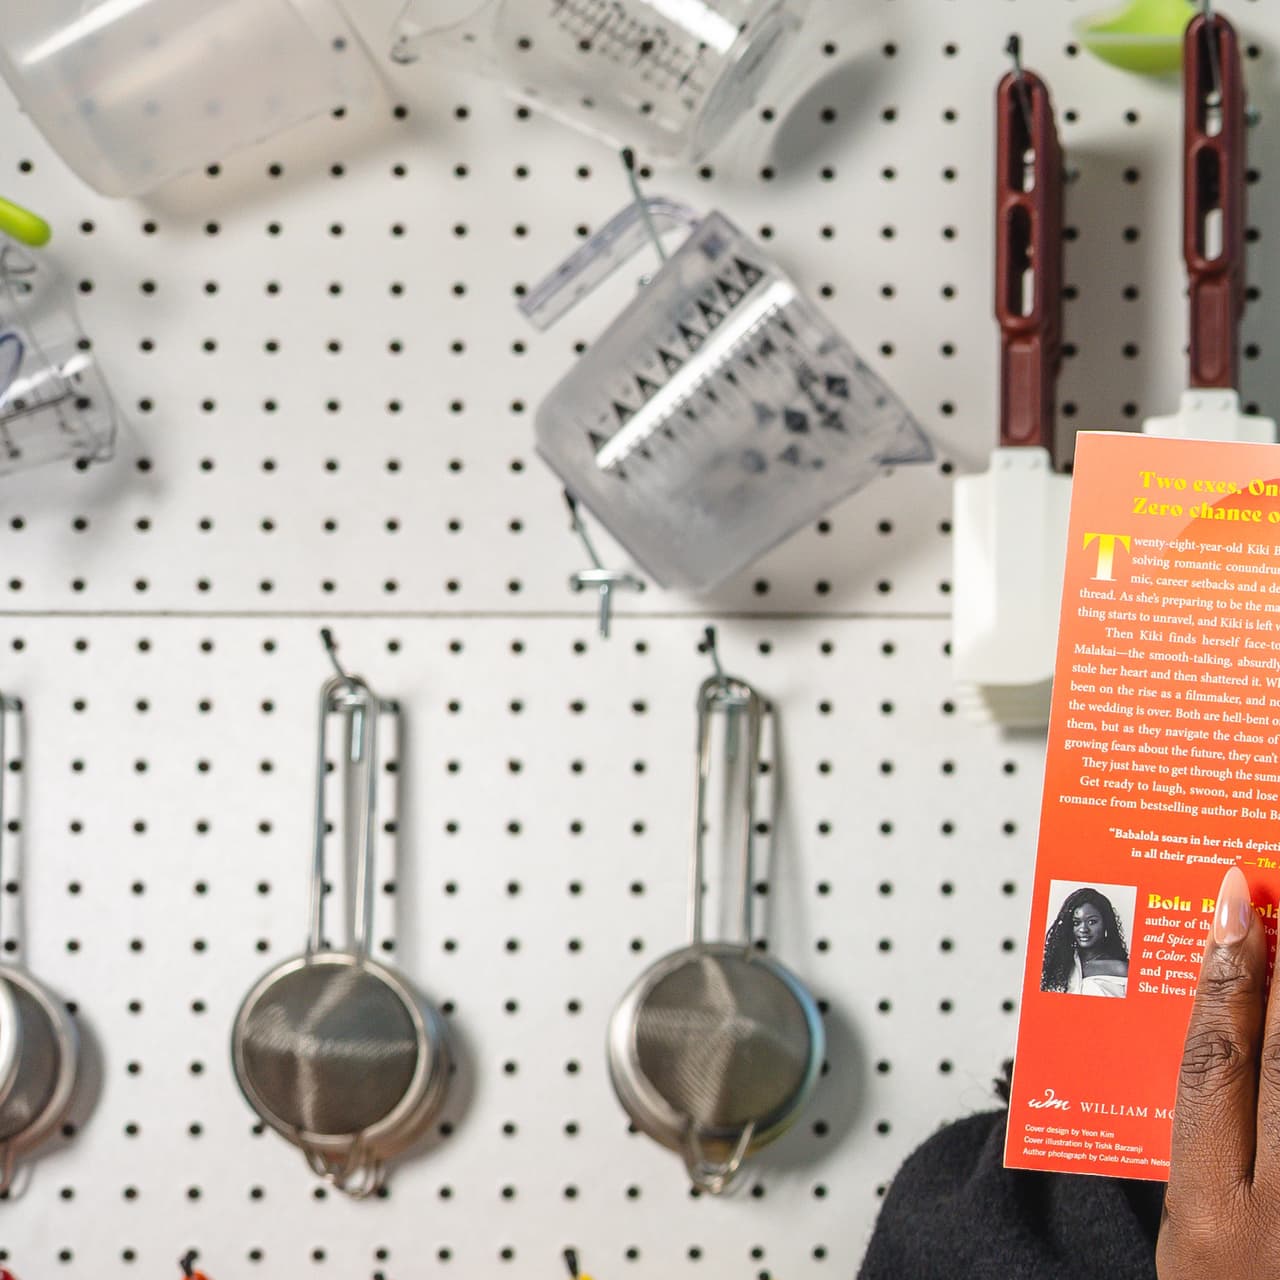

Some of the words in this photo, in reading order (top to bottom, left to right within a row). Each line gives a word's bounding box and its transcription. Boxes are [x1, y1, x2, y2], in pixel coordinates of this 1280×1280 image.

[1139, 471, 1187, 490] Two
[1194, 478, 1241, 494] exes.
[1132, 497, 1183, 517] Zero
[1189, 502, 1262, 522] chance
[1148, 894, 1191, 912] Bolu
[1080, 1101, 1148, 1117] WILLIAM
[1025, 1124, 1044, 1133] Cover
[1047, 1126, 1069, 1135] design
[1071, 1128, 1079, 1136] by
[1082, 1129, 1098, 1137] Yeon
[1024, 1136, 1043, 1145] Cover
[1045, 1138, 1082, 1147] illustration
[1084, 1141, 1092, 1149] by
[1115, 1143, 1143, 1154] Barzanji
[1023, 1148, 1045, 1156] Author
[1048, 1150, 1086, 1160] photograph
[1089, 1154, 1097, 1162] by
[1099, 1154, 1119, 1163] Caleb
[1121, 1156, 1148, 1165] Azumah
